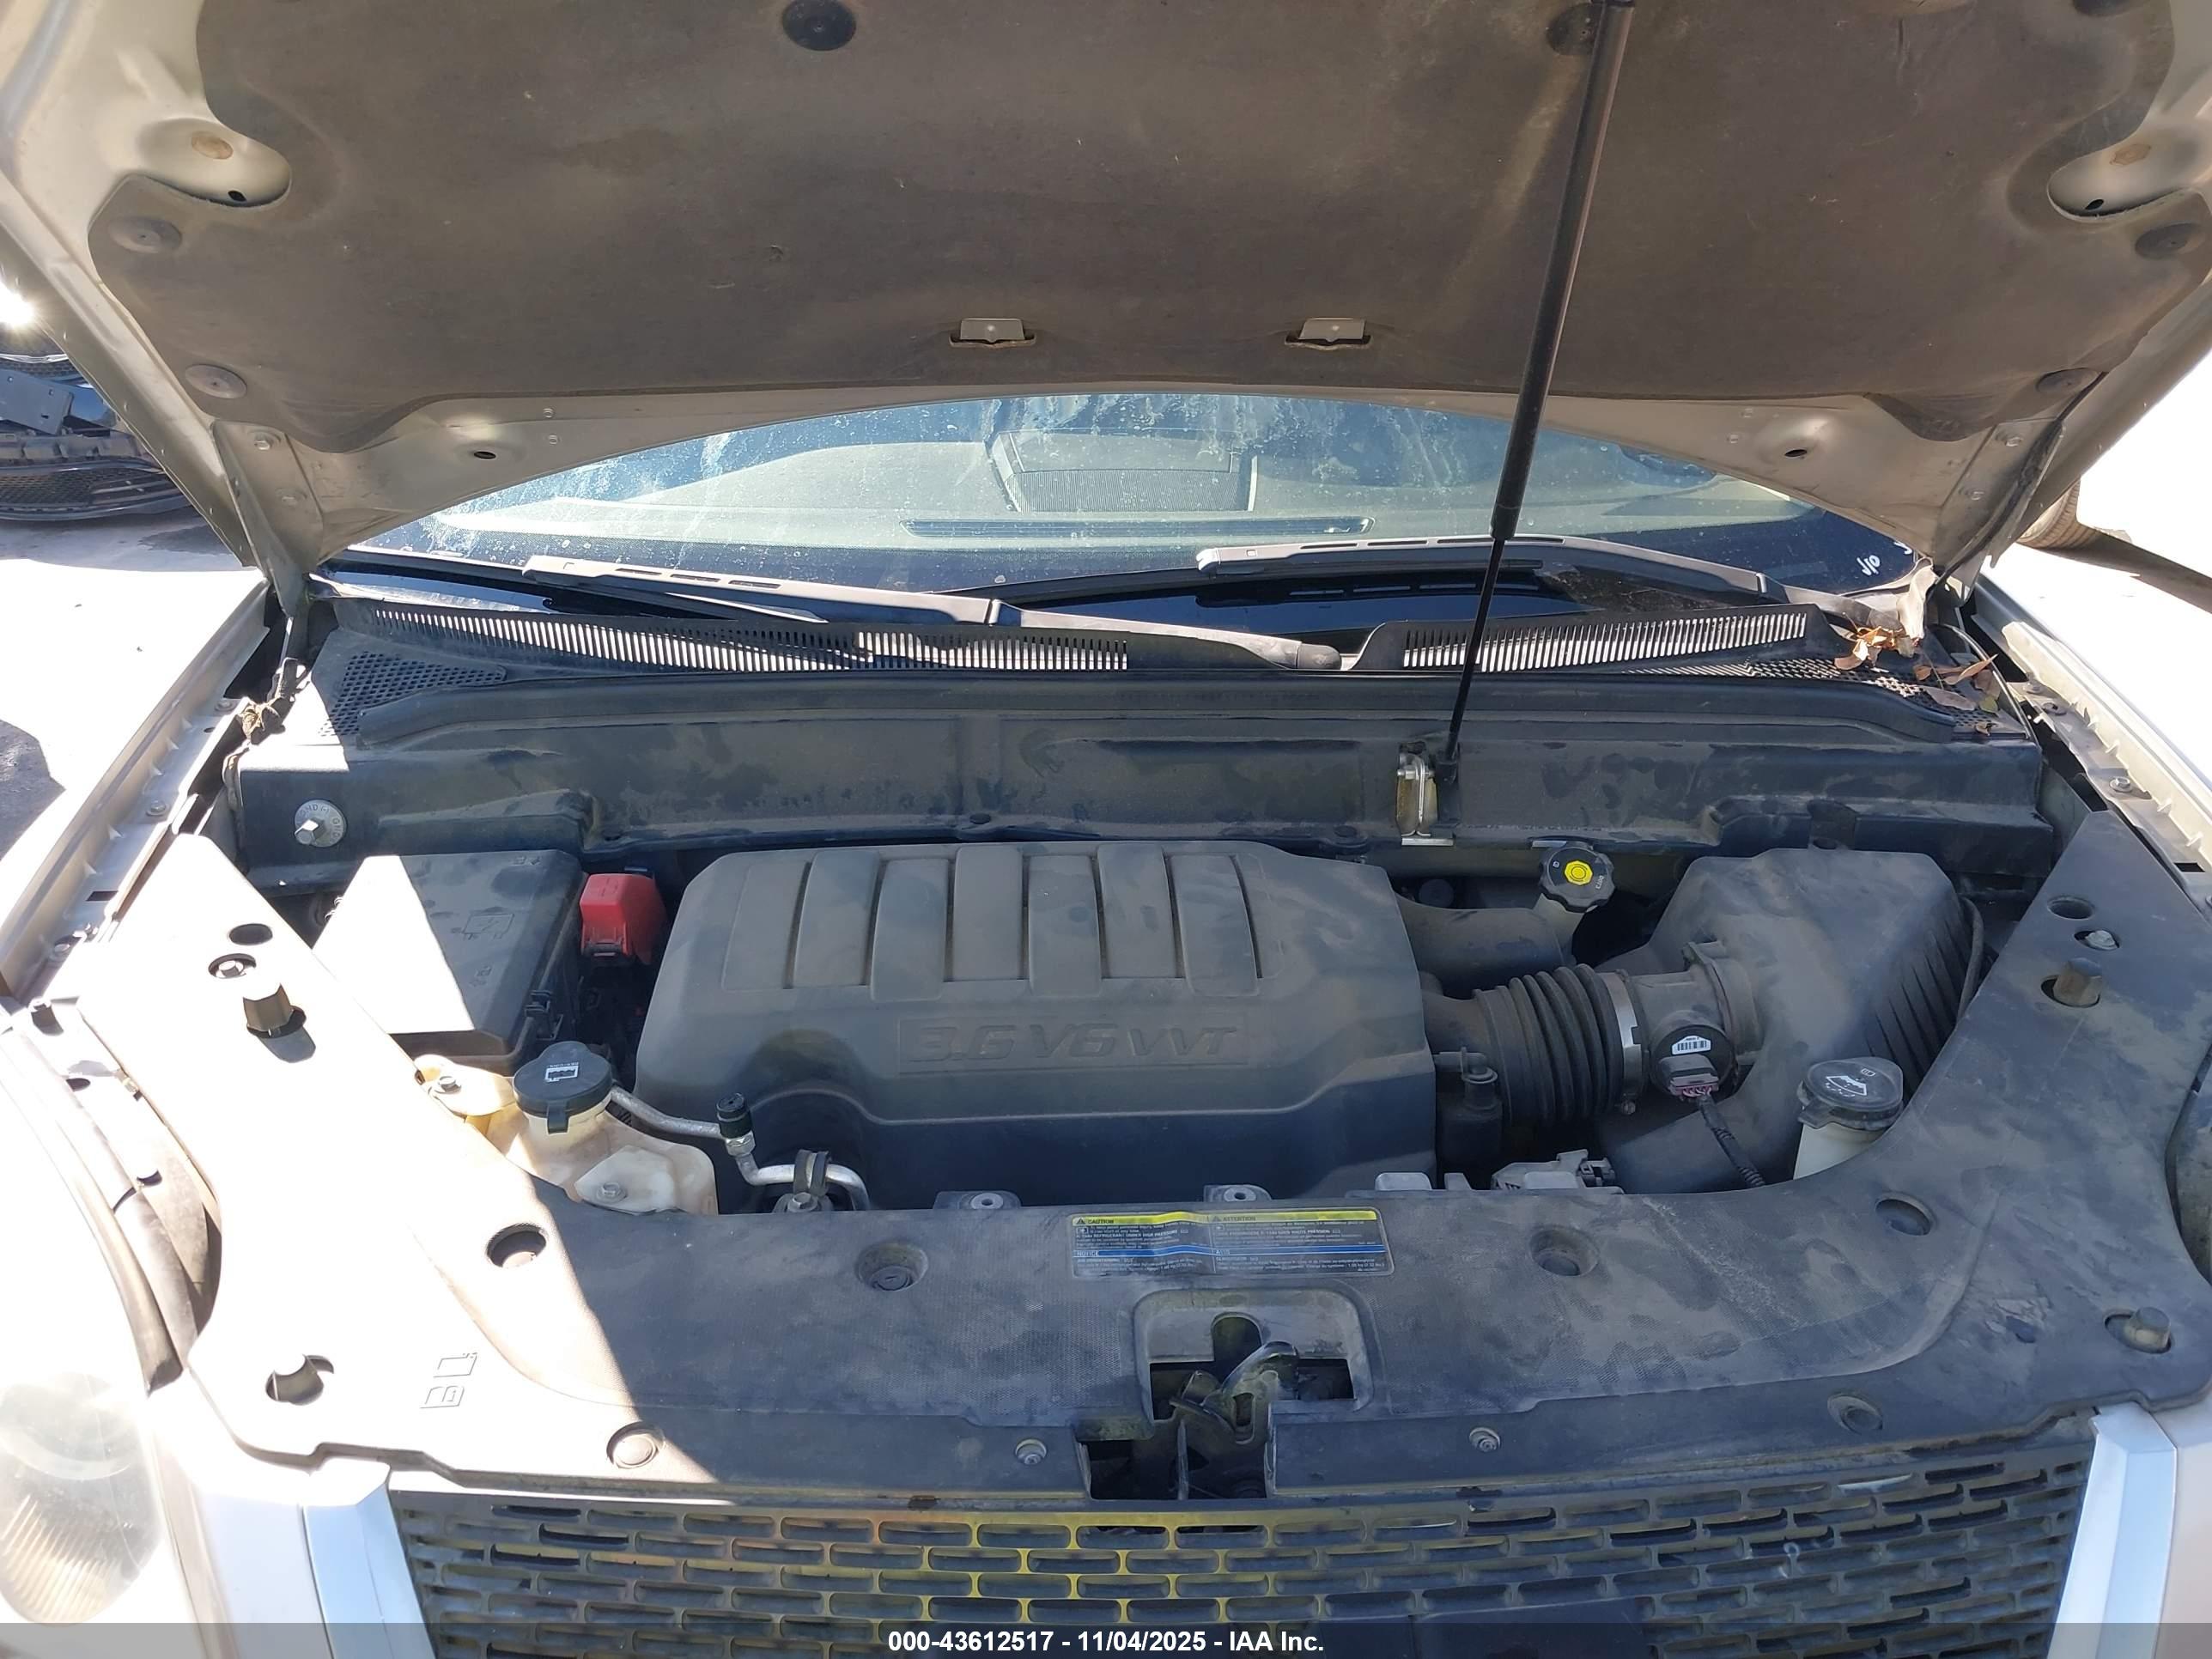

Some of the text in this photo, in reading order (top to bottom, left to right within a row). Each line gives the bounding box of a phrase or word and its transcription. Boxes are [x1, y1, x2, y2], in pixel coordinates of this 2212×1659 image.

[907, 1023, 1237, 1062] 3.6 V6 VVT
